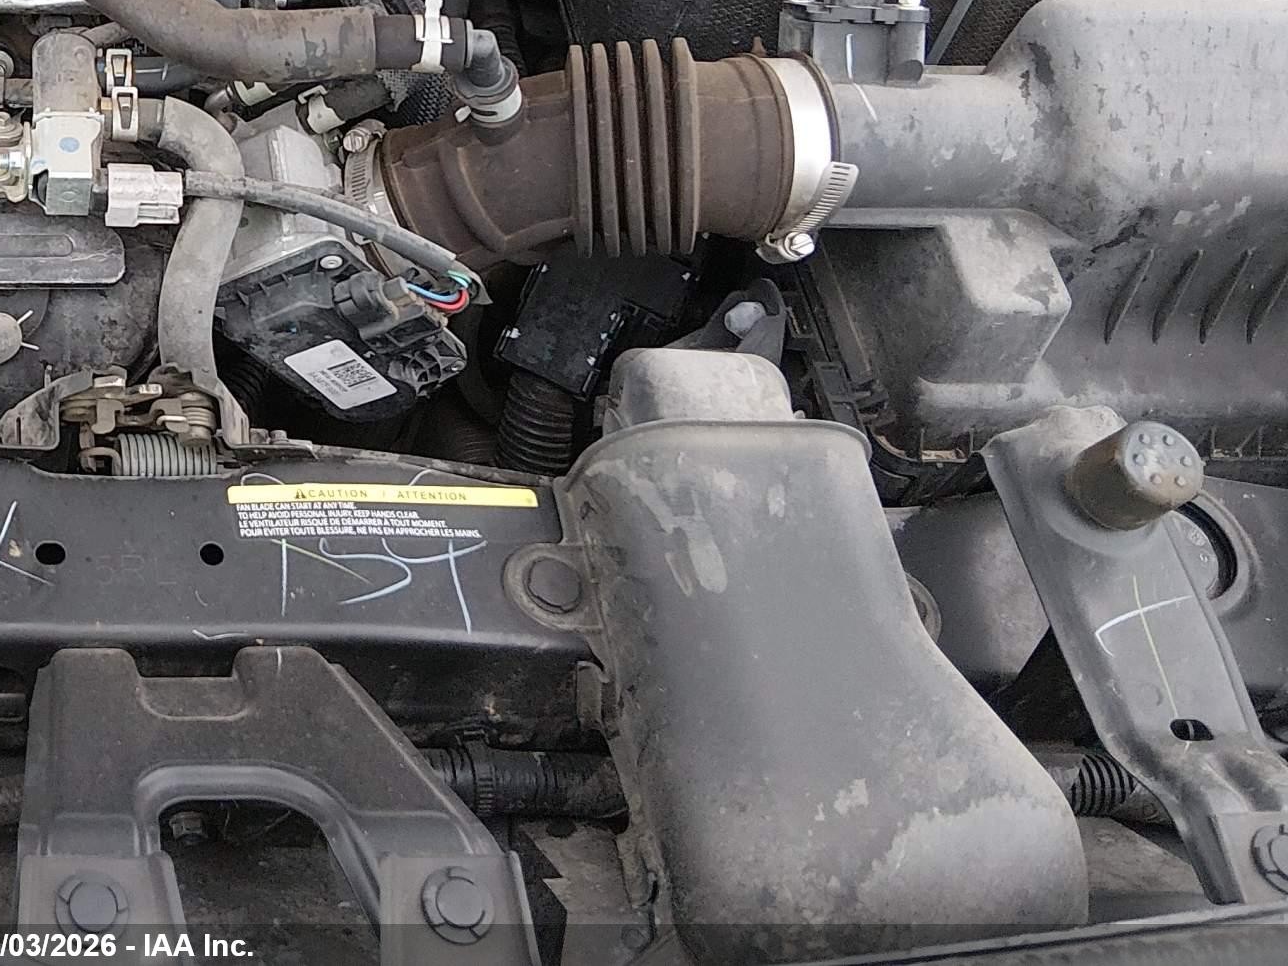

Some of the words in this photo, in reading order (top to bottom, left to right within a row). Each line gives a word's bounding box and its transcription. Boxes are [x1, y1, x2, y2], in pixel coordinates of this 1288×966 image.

[309, 490, 368, 498] CAUTION
[397, 490, 467, 501] ATTENTION
[237, 503, 251, 511] FAN
[252, 503, 274, 511] BLADE
[323, 502, 338, 510] ANY
[238, 512, 248, 520] TO
[268, 511, 290, 519] AVOID
[353, 510, 370, 518] KEEP
[371, 510, 396, 518] HANDS
[239, 520, 248, 528] LE
[249, 519, 300, 528] VENTILATEUR
[329, 518, 340, 526] DE
[391, 519, 411, 527] TOUT
[240, 528, 262, 537] POUR
[290, 527, 316, 535] TOUTE
[357, 527, 368, 535] NE
[368, 527, 383, 535] PAS
[385, 527, 395, 535] EN
[395, 527, 439, 536] APPROCHER
[440, 528, 454, 536] LES
